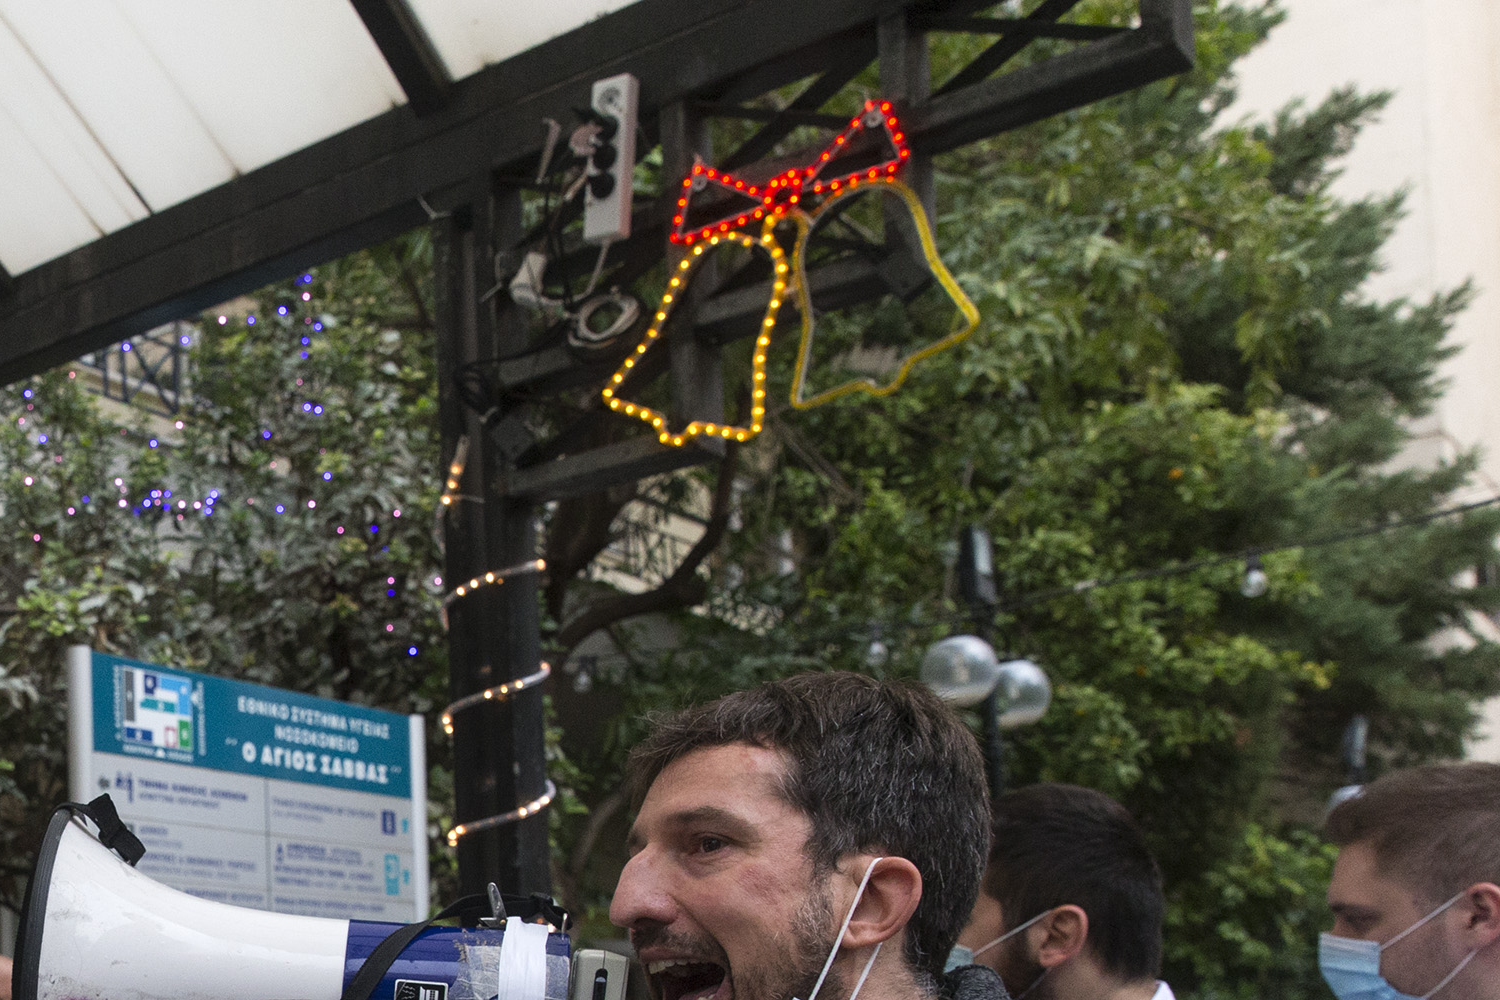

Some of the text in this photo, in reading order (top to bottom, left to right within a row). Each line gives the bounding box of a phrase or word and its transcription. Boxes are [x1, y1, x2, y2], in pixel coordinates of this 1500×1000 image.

[236, 694, 290, 721] ΕΘΝΙΚΟ
[290, 705, 348, 733] ΣΥΣΤΗΜΑ
[273, 724, 360, 754] ΝΟΣΟΚΟΜΕΙΟ
[260, 744, 318, 774] ΑΓΙΟΣ
